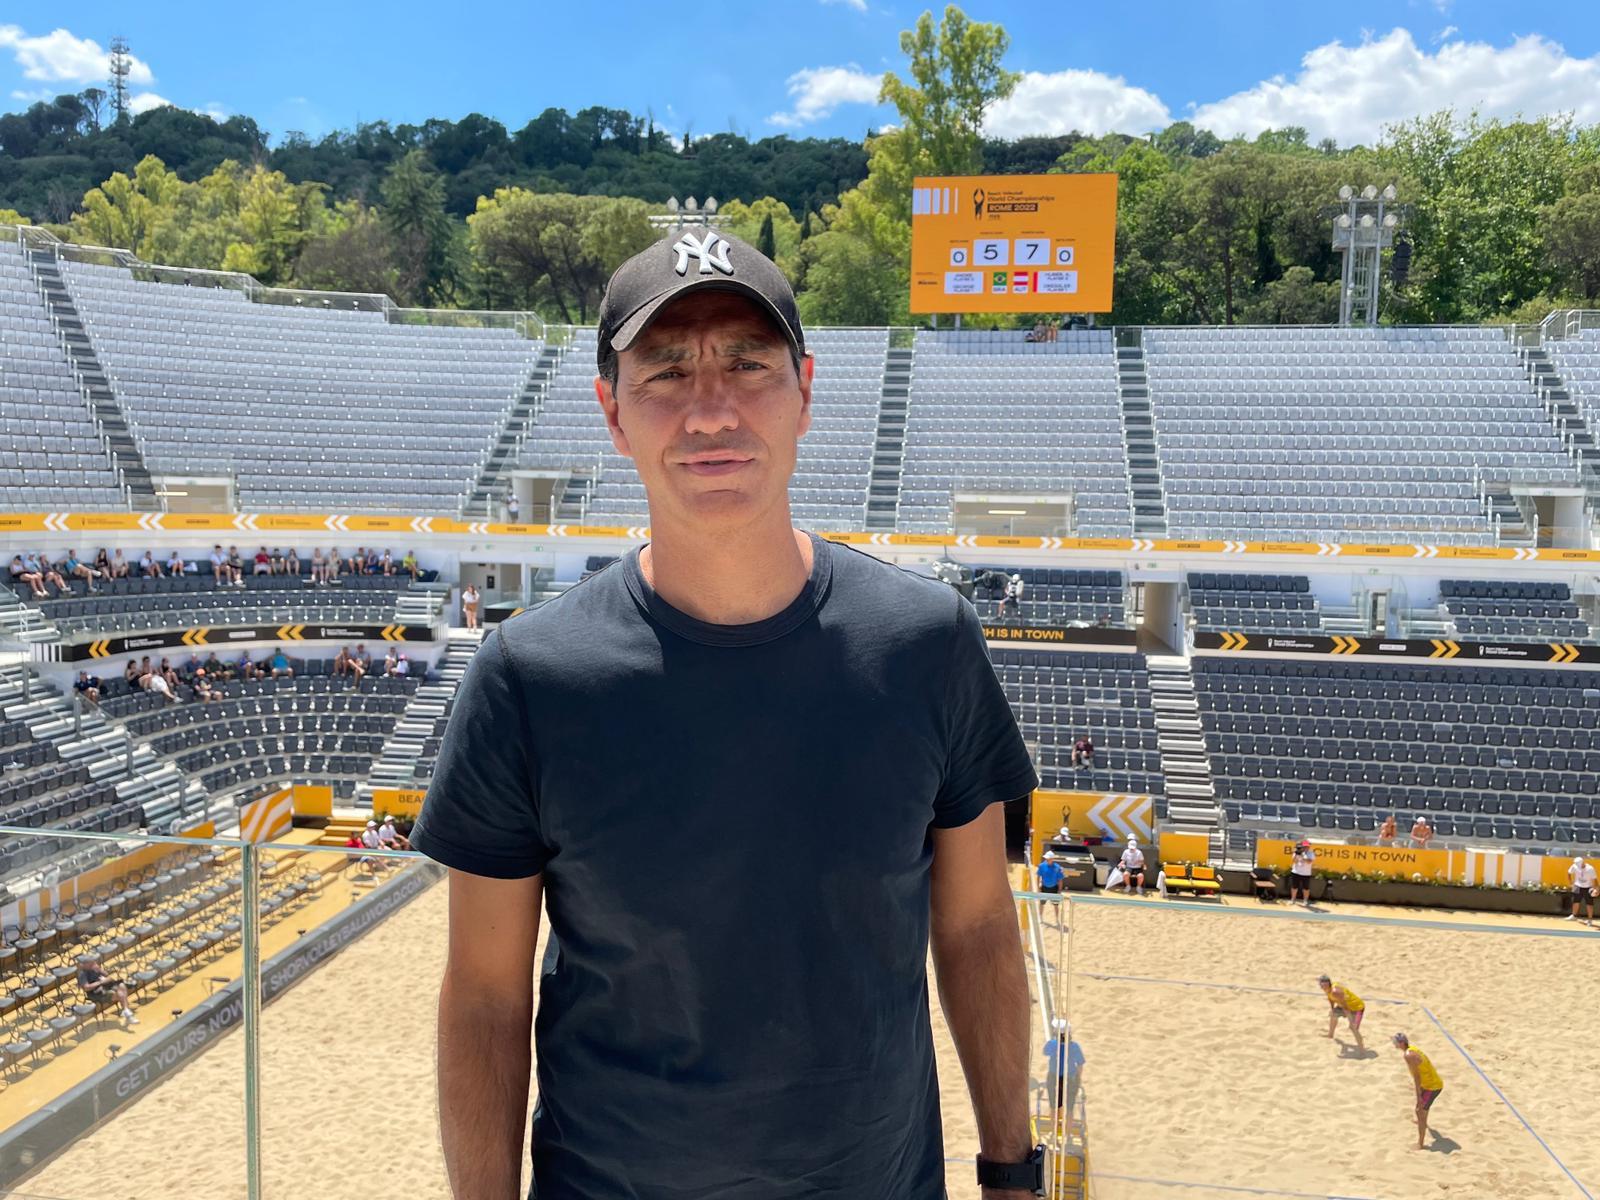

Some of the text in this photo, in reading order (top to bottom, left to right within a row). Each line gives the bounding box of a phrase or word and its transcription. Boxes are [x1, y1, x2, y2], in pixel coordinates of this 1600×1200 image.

[1014, 203, 1036, 211] 2022
[953, 243, 1071, 263] 0 5 7 0
[997, 628, 1008, 638] IS
[1011, 629, 1022, 638] IN
[1025, 629, 1065, 640] TOWN
[398, 794, 425, 804] BEA
[1284, 846, 1416, 863] BCH IS IN TOWN
[116, 1062, 151, 1097] GET
[153, 1023, 207, 1070] YOURS
[208, 1000, 244, 1032] NOW
